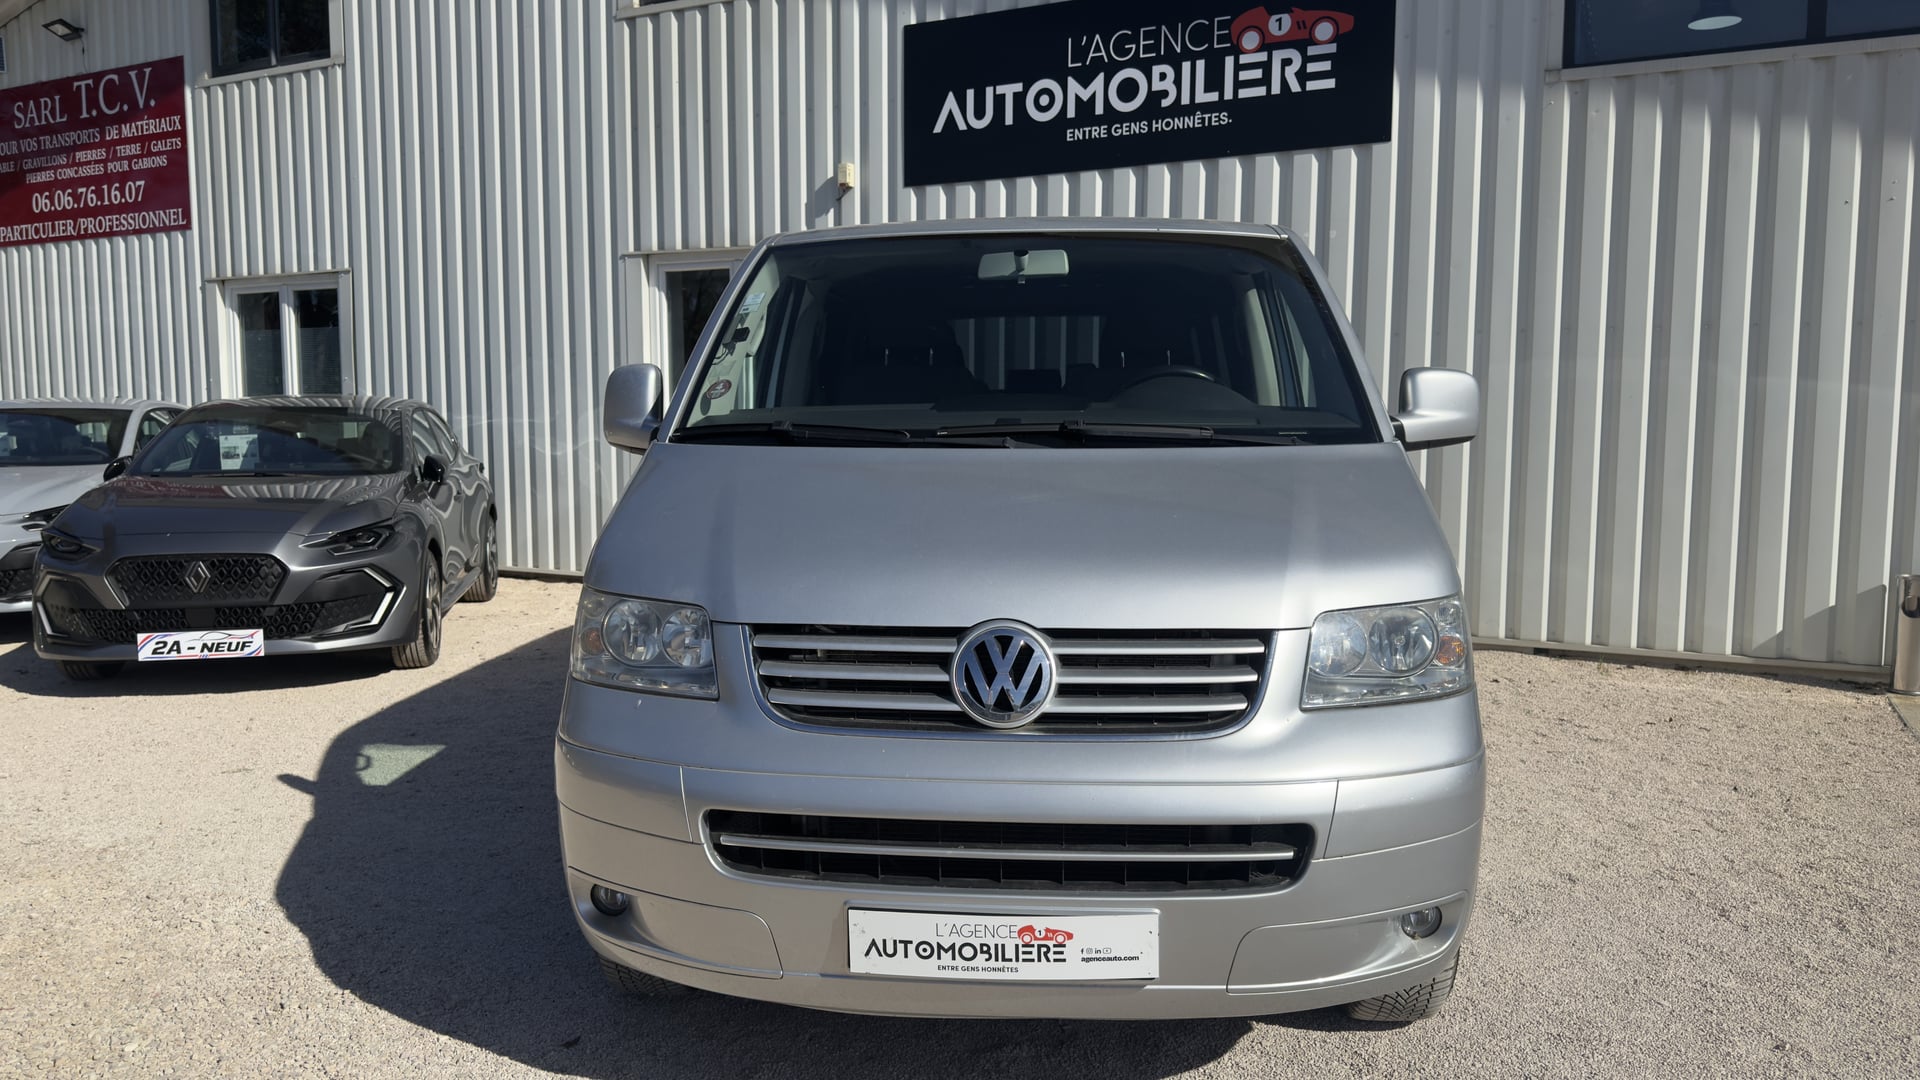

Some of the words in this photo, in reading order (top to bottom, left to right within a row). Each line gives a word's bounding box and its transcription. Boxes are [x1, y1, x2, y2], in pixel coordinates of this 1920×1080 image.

[1067, 15, 1232, 68] L'AGENCE
[13, 95, 68, 129] SARL
[73, 67, 156, 119] T.C.V.
[0, 141, 19, 156] OUR
[20, 137, 38, 152] VOS
[39, 128, 101, 150] TRANSPORTS
[105, 125, 119, 141] DE
[121, 115, 182, 138] MATÉRIAUX
[1066, 125, 1108, 142] ENTRE
[1111, 120, 1149, 137] GENS
[1152, 110, 1233, 133] HONNÊTES.
[0, 161, 15, 173] ABLE
[23, 154, 67, 170] GRAVILLONS
[75, 148, 107, 163] PIERRES
[115, 143, 142, 157] TERRE
[150, 137, 182, 152] GALETS
[26, 170, 55, 184] PIERRES
[57, 162, 105, 180] CONCASSÉES
[107, 160, 129, 174] POUR
[131, 155, 168, 170] GABIONS
[32, 180, 146, 213] 06.06.76.16.07
[0, 208, 187, 242] PARTICULIER/PROFESSIONNEL
[151, 640, 182, 656] 2A
[200, 640, 254, 653] NEUF
[981, 965, 1019, 973] HONNÊTES
[1080, 955, 1140, 963] agenceauto.com
